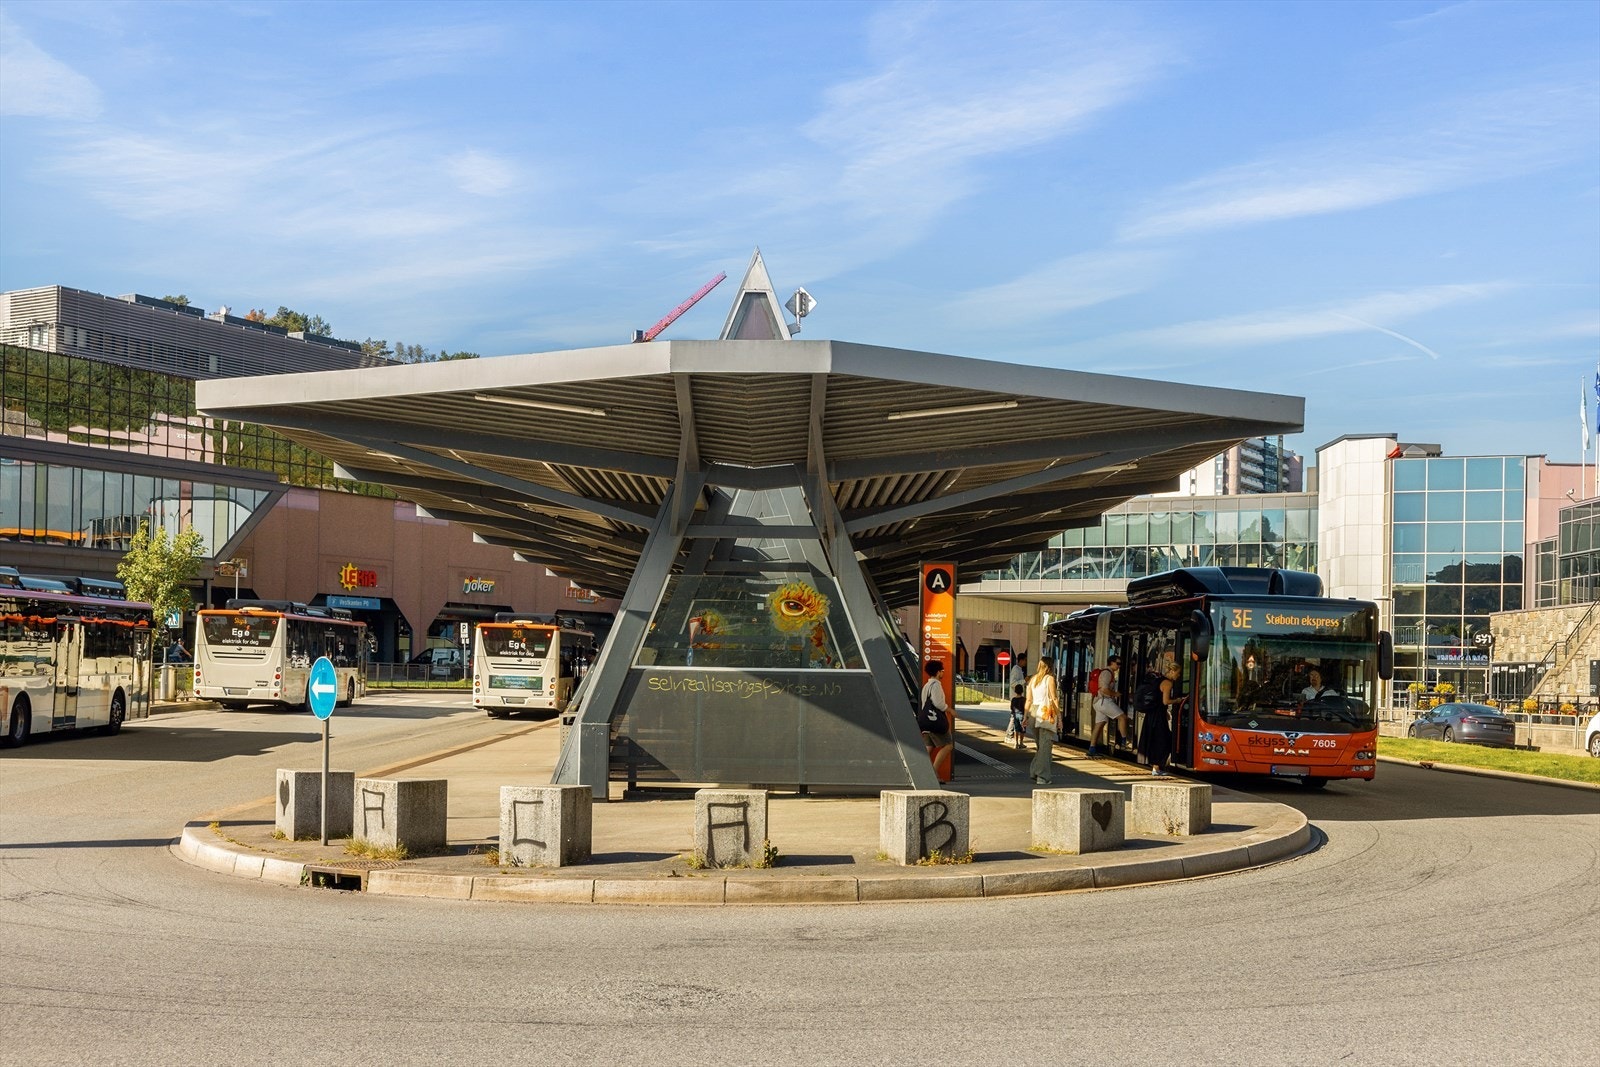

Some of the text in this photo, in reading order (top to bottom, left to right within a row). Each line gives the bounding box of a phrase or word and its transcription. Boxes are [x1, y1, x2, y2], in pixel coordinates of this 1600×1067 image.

[931, 573, 945, 589] A
[1231, 608, 1253, 629] 3E
[1265, 613, 1340, 629] Støbotn ekspress
[231, 628, 243, 638] Eg
[508, 640, 520, 650] Eg
[1247, 734, 1286, 748] skyss
[1312, 739, 1337, 748] 7605
[1273, 747, 1310, 756] MAN
[919, 801, 957, 858] B
